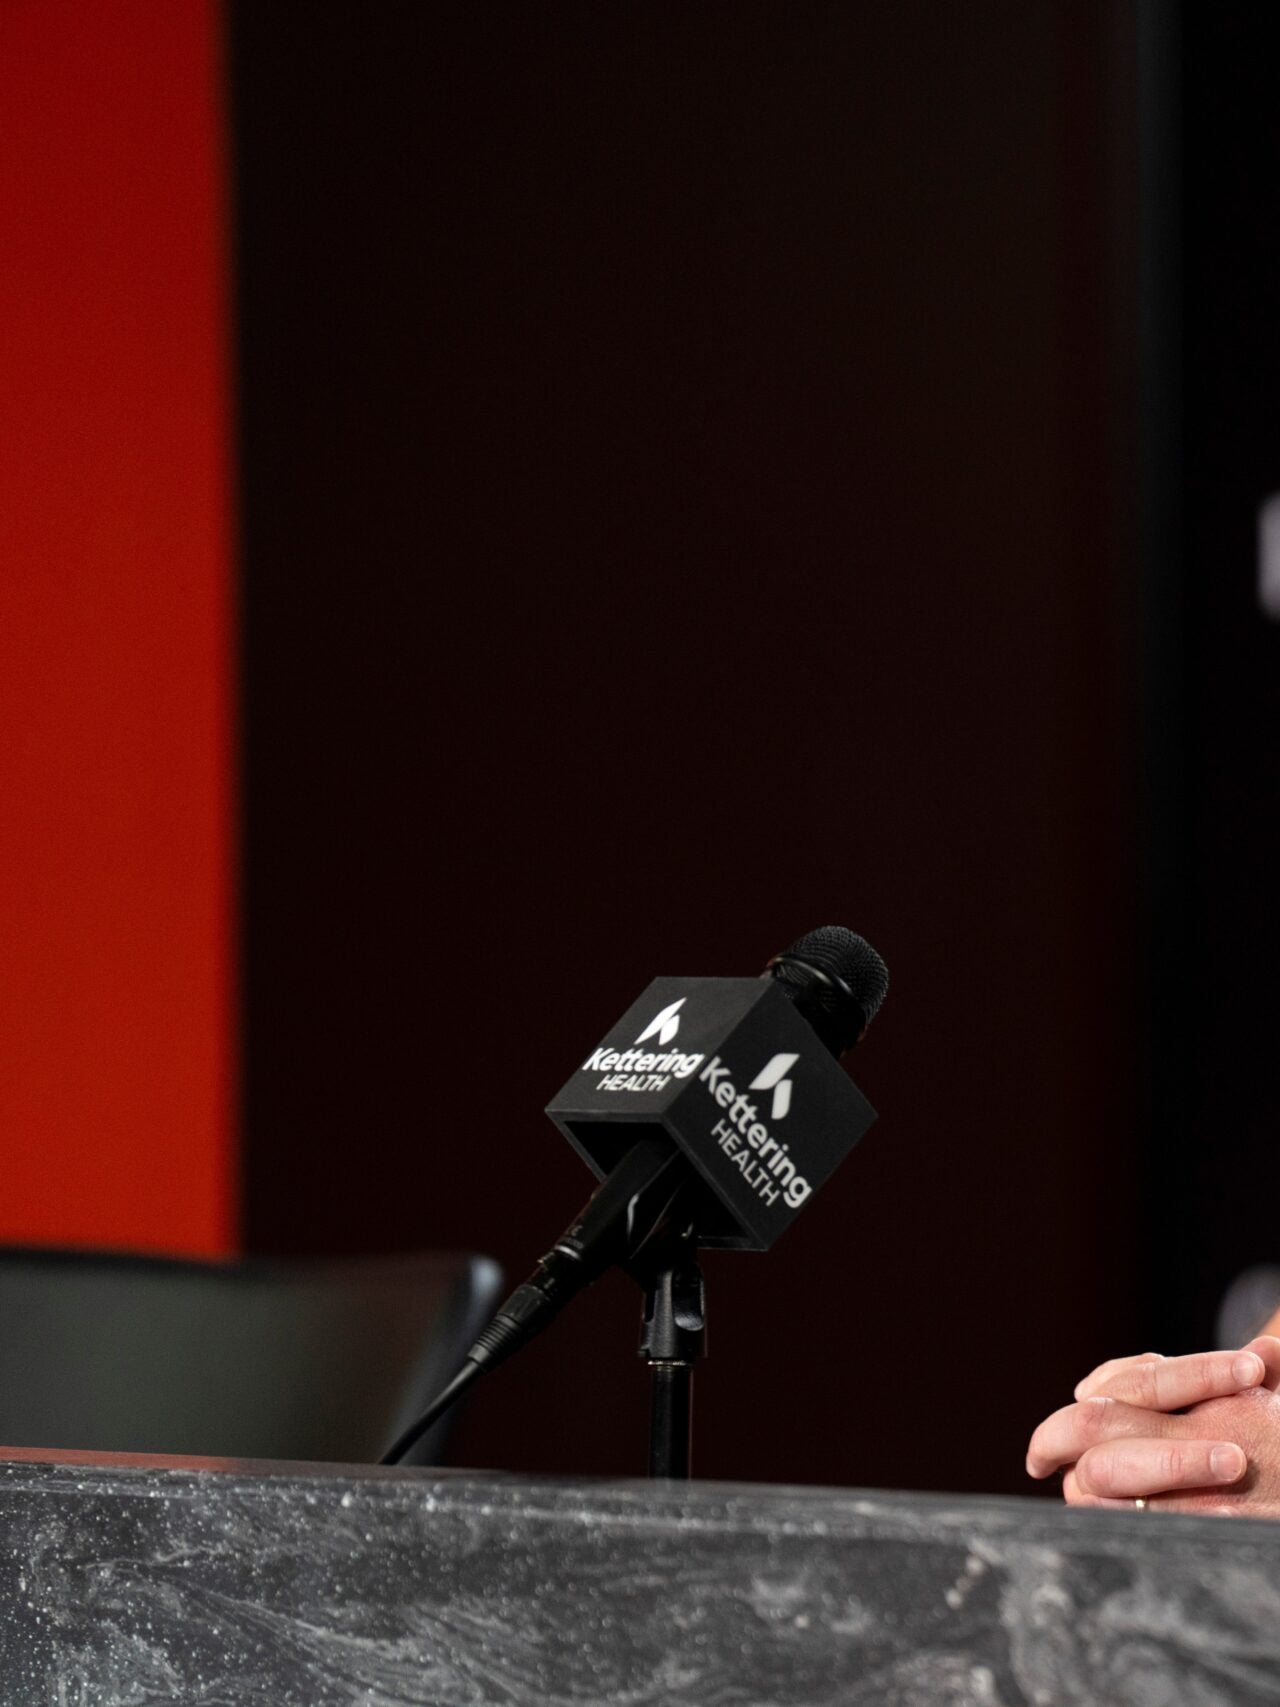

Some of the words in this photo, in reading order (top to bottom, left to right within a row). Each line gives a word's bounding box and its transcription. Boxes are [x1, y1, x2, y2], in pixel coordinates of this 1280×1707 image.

[582, 1047, 705, 1079] Kettering
[596, 1074, 672, 1092] HEALTH
[699, 1055, 813, 1209] Kettering
[710, 1118, 780, 1207] HEALTH
